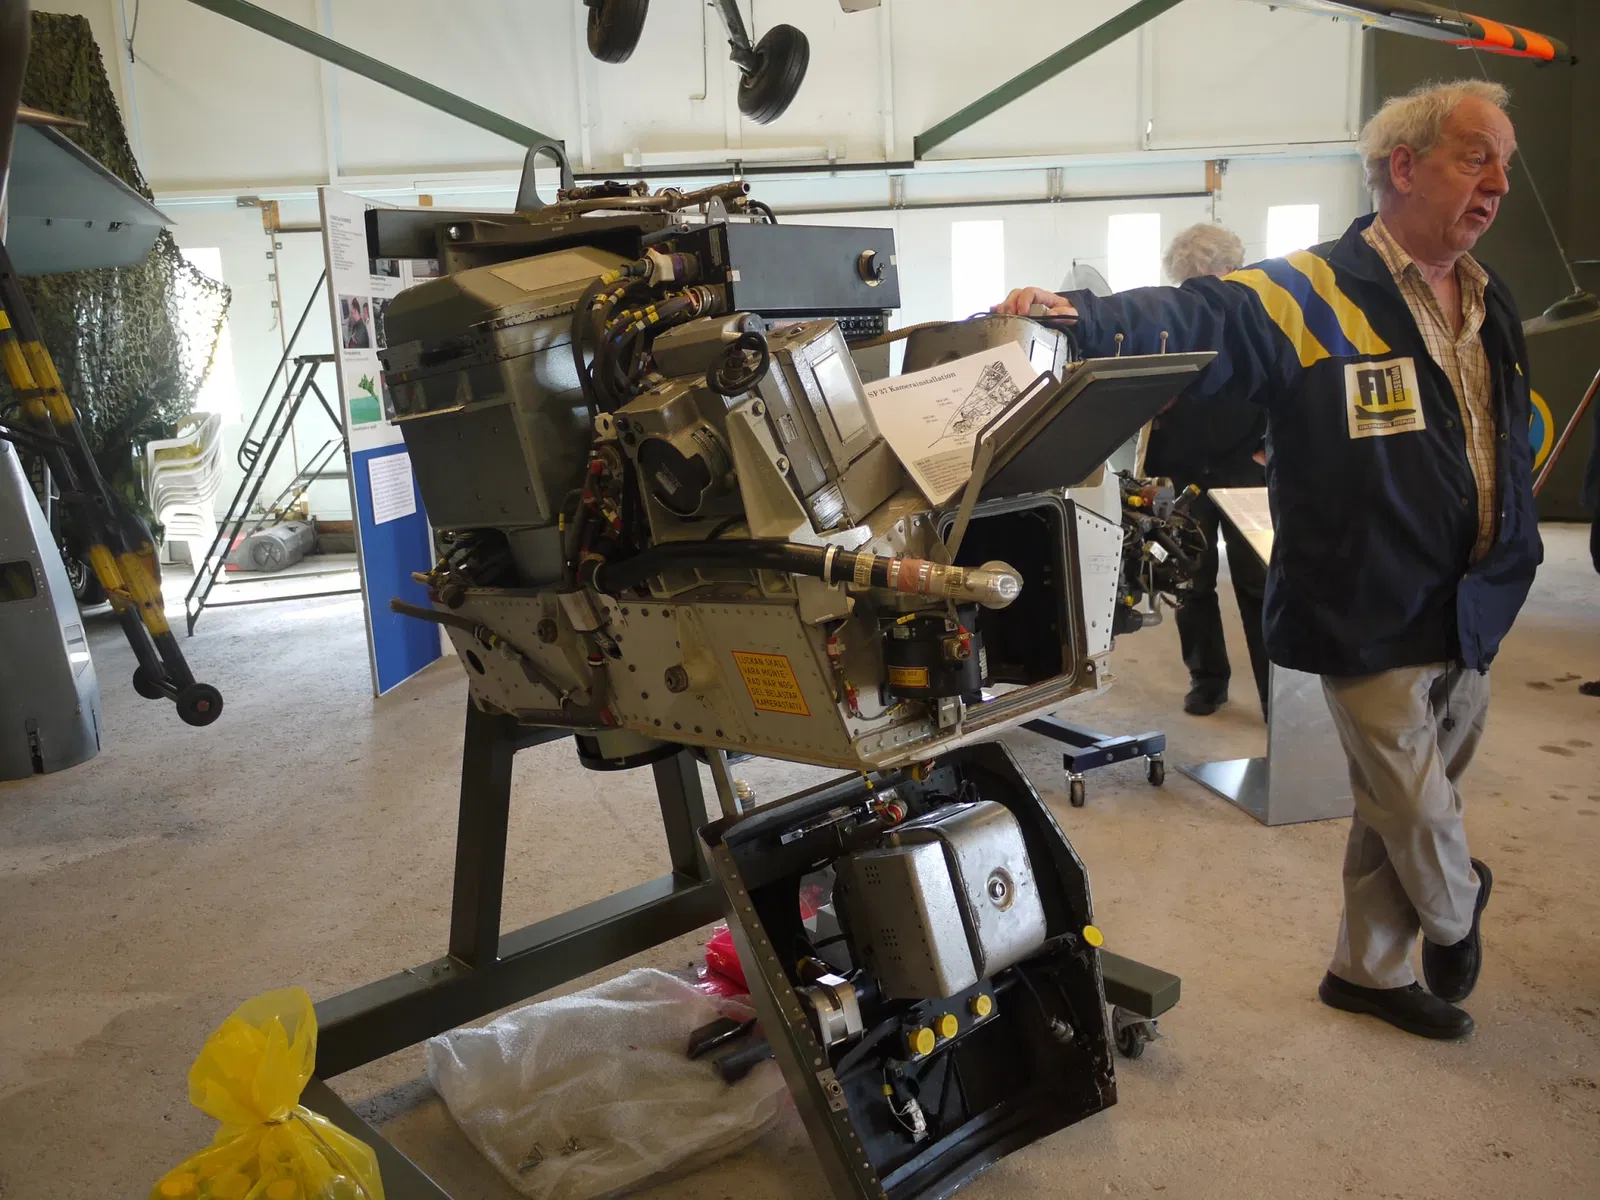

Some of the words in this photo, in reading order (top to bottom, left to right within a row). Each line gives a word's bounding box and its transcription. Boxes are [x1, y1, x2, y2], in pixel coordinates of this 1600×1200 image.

[868, 390, 878, 398] SF
[888, 373, 956, 391] Kamerainstallation
[1391, 366, 1404, 402] MUSEUM
[765, 659, 786, 668] SKALL
